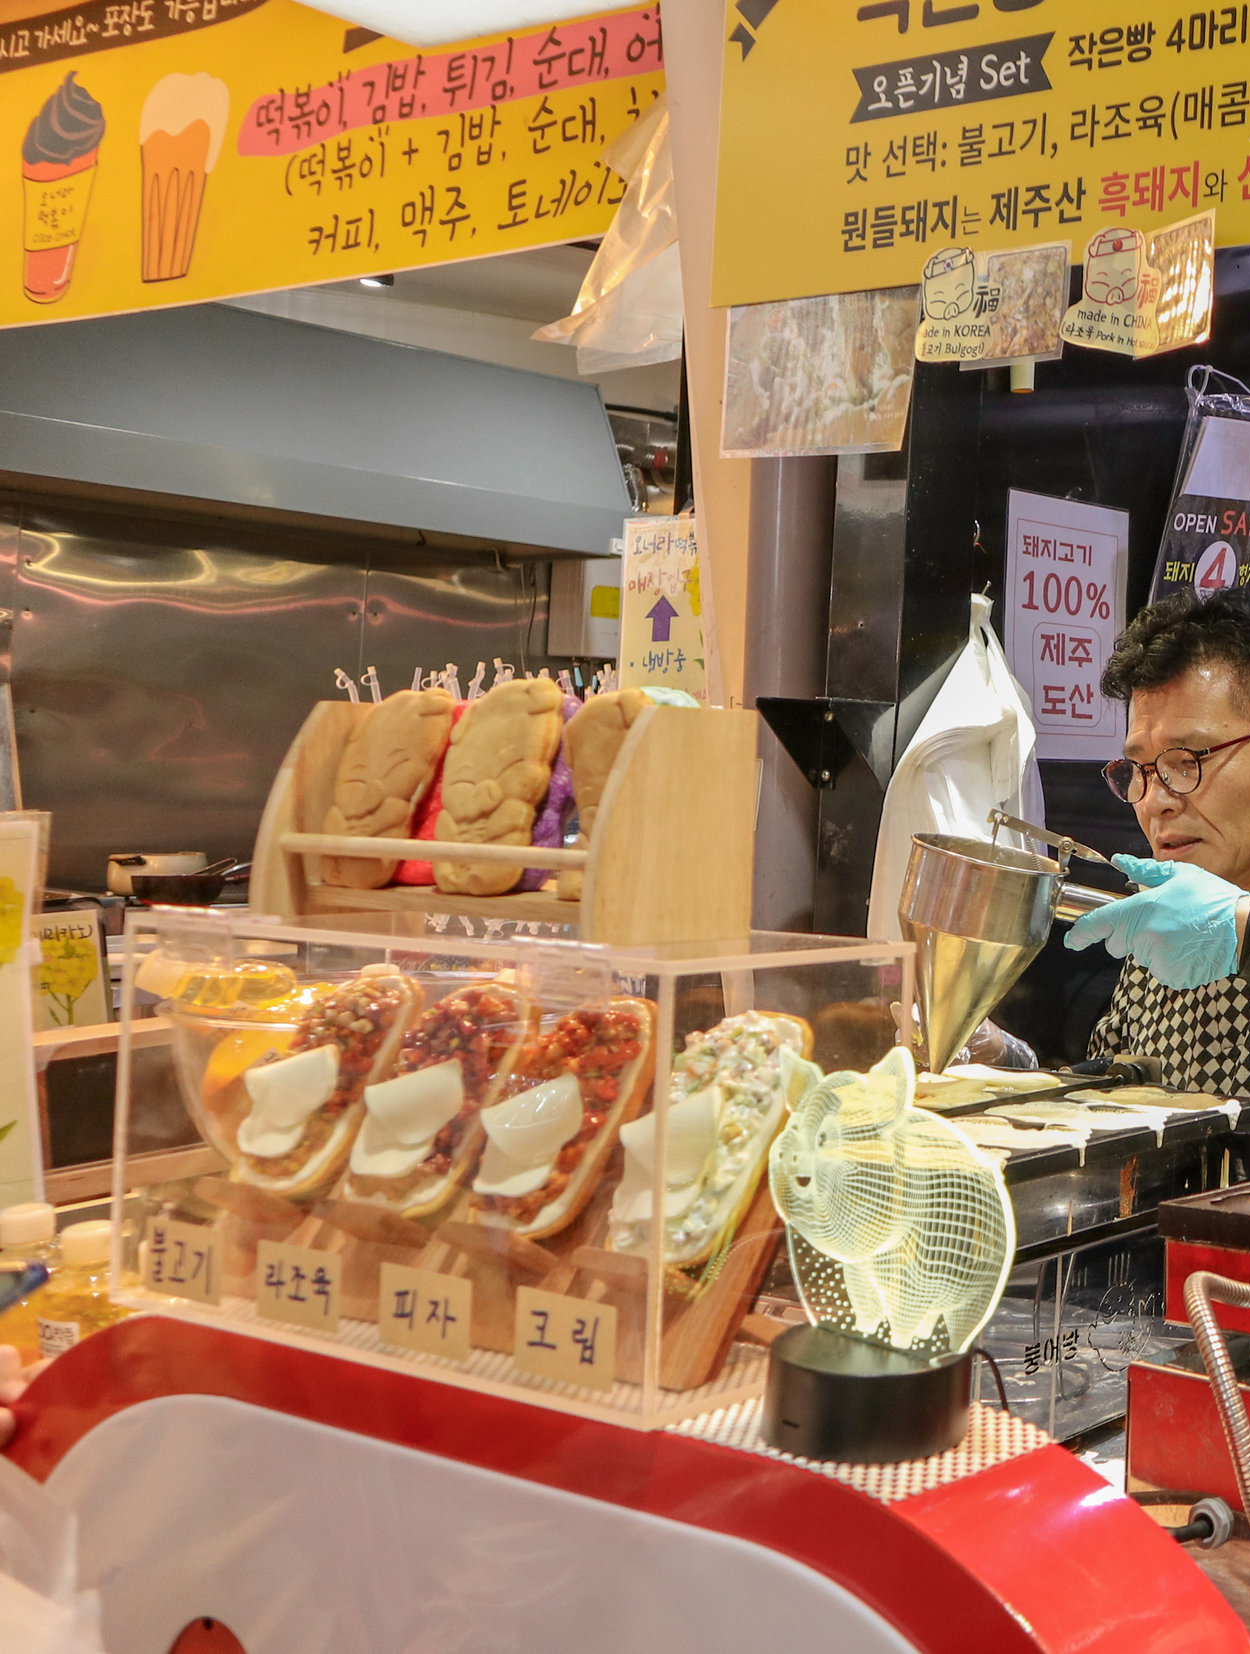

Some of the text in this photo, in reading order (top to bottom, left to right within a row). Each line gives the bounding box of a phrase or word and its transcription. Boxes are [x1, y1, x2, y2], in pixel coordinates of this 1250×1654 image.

[1068, 21, 1156, 72] 작은빵
[1166, 7, 1248, 54] 4마리
[866, 50, 1031, 112] 오픈기념 Set
[845, 143, 873, 184] 맛
[882, 139, 947, 179] 선택:
[958, 112, 1058, 168] 불고기,
[308, 208, 379, 256] 커피,
[402, 184, 477, 248] 맥주,
[841, 193, 983, 253] 뭔들돼지는
[989, 176, 1087, 231] 제주산
[1098, 160, 1228, 218] 흑돼지와
[973, 285, 1001, 319] 福
[1077, 309, 1107, 323] made
[1110, 313, 1120, 326] in
[922, 324, 991, 338] ade in KOREA
[1095, 330, 1116, 343] Pork
[944, 341, 985, 358] Bulgogi)
[1172, 512, 1217, 534] OPEN
[1022, 535, 1093, 566] 돼지고기
[1163, 561, 1195, 583] 돼지
[1200, 547, 1228, 589] 4
[1021, 569, 1111, 620] 100%
[1040, 632, 1093, 668] 제주
[1041, 683, 1094, 719] 도산
[150, 1226, 213, 1297] 불고기
